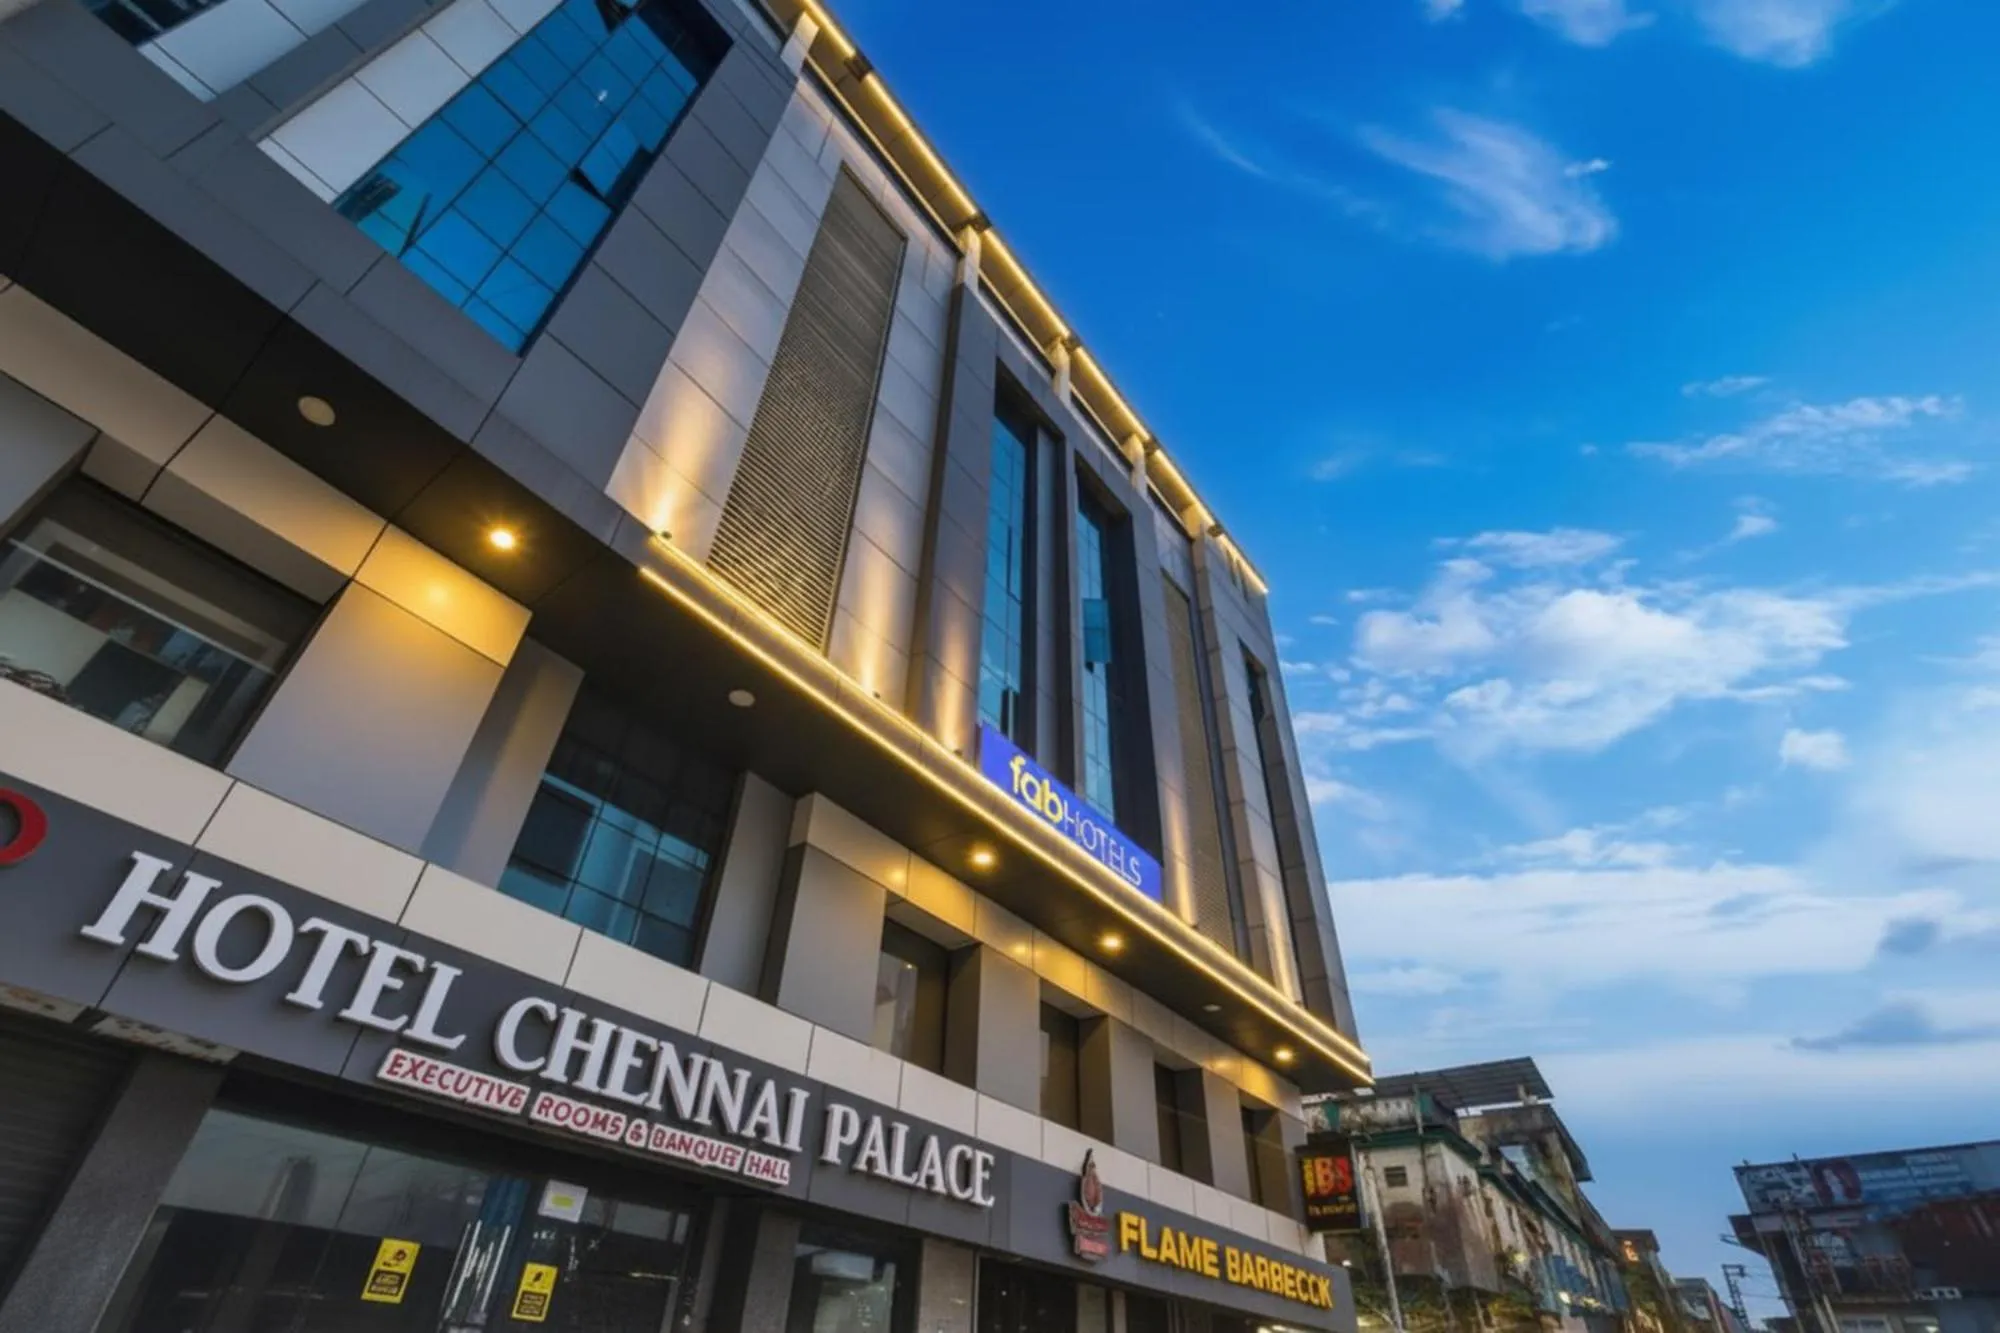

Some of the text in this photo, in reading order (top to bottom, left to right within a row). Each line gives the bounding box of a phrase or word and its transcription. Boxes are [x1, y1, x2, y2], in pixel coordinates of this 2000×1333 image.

[80, 850, 996, 1208] HOTEL CHENNAI PALACE
[385, 1053, 526, 1109] EXECUTIVE
[535, 1095, 624, 1141] ROOMS
[628, 1121, 643, 1143] &
[749, 1151, 789, 1181] HALL
[1118, 1211, 1220, 1279] FLAME
